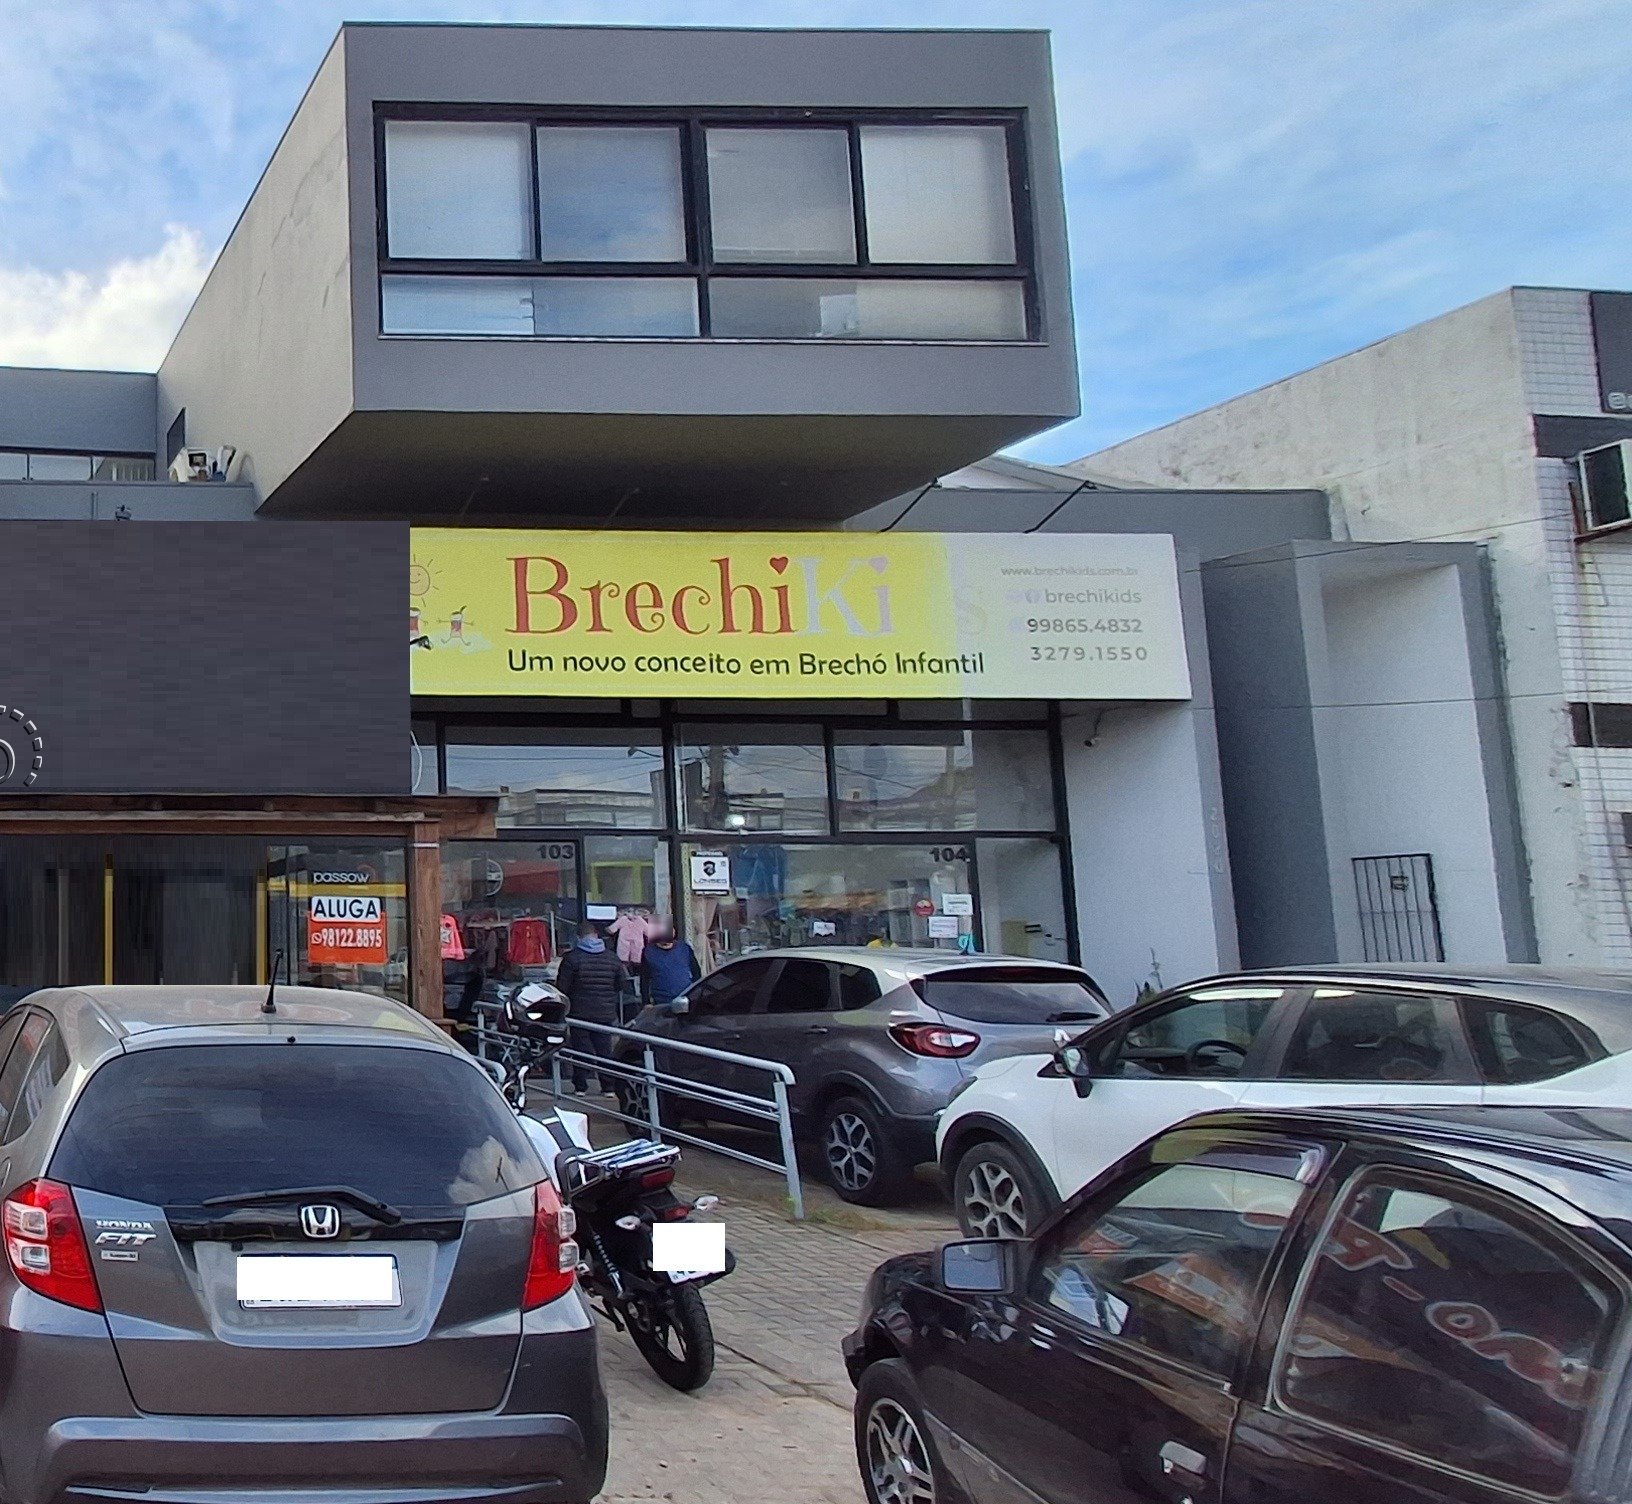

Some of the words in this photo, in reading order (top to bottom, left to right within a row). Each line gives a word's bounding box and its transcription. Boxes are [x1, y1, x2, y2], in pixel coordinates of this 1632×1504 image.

[1044, 588, 1143, 604] brechikids
[1026, 618, 1144, 634] 99865.4832
[1030, 646, 1148, 662] 3279.1550
[507, 649, 554, 672] Um
[562, 655, 627, 673] novo
[634, 652, 742, 675] conceito
[749, 658, 790, 676] em
[799, 652, 888, 676] Brechó
[895, 652, 985, 675] Infantil
[536, 844, 575, 860] 103
[930, 847, 969, 863] 104
[313, 872, 370, 884] passow
[313, 899, 379, 919] ALUGA
[321, 928, 383, 948] 98122.8895
[95, 1219, 156, 1232] HONDA
[94, 1232, 157, 1246] FIT
